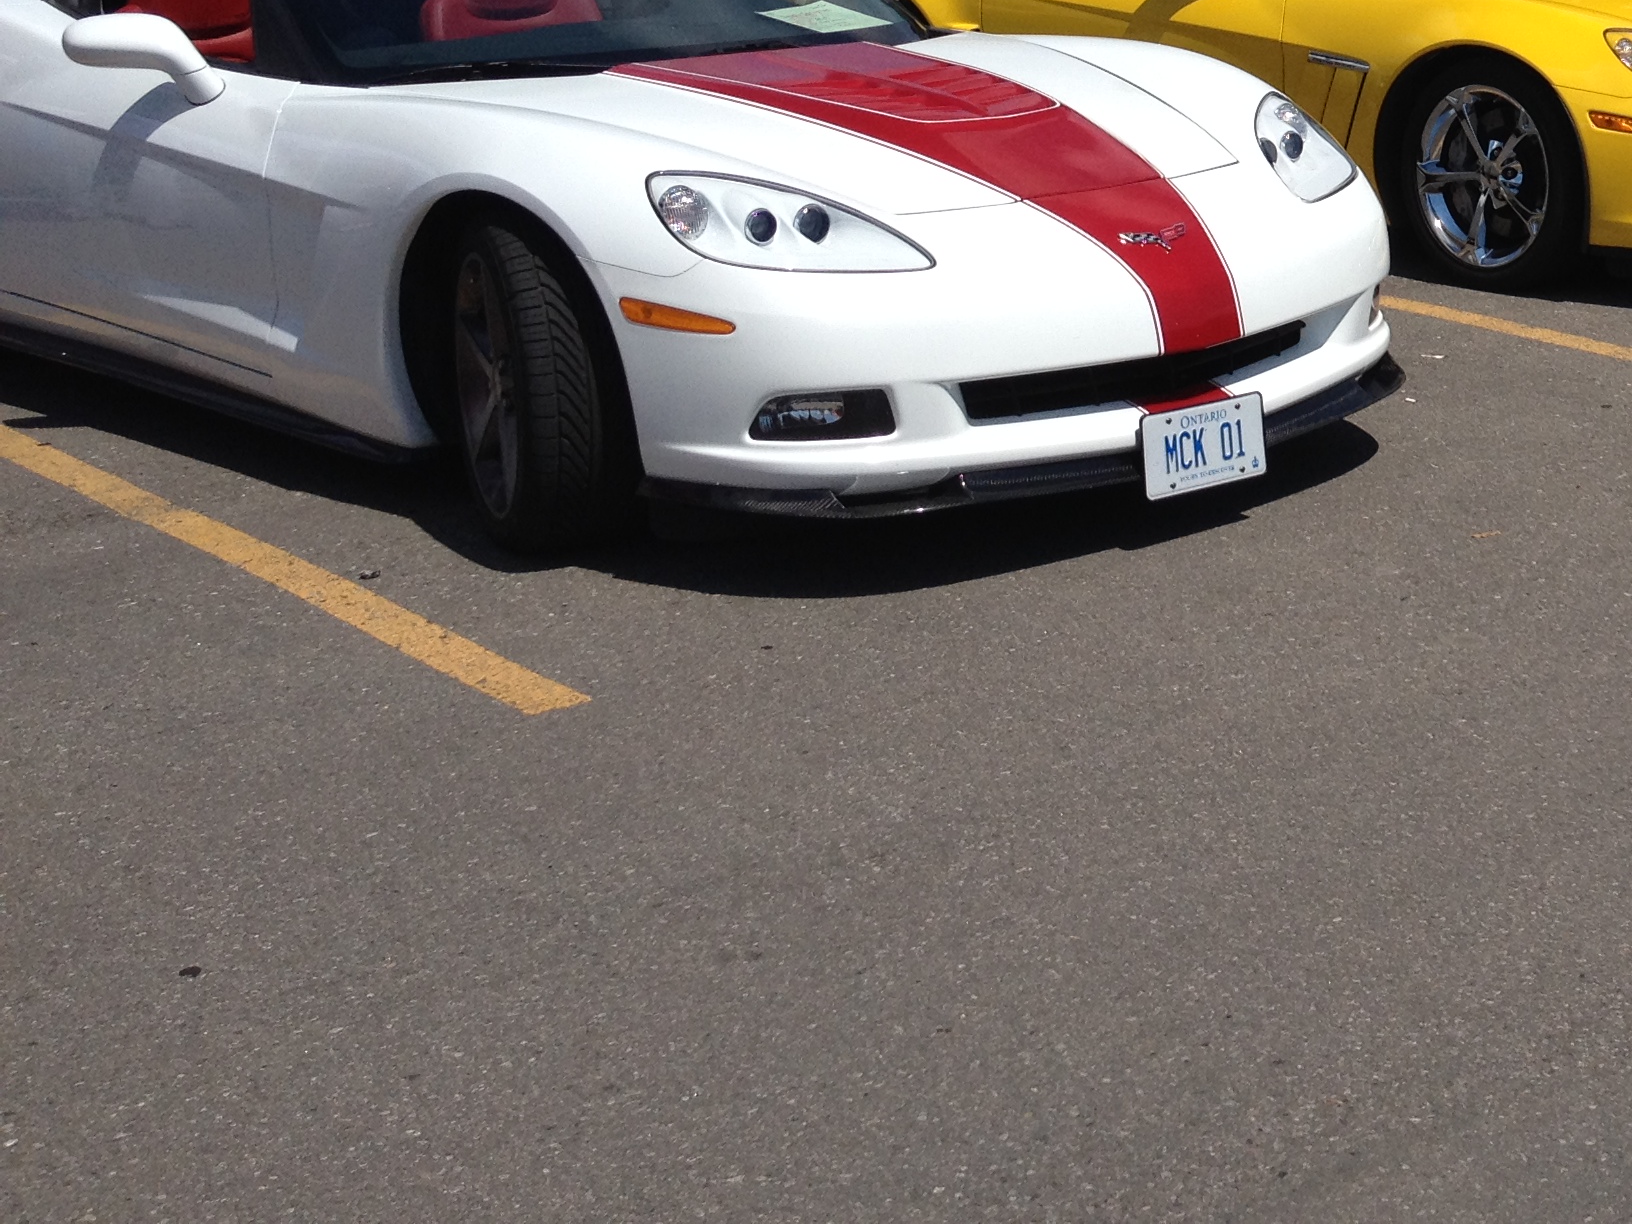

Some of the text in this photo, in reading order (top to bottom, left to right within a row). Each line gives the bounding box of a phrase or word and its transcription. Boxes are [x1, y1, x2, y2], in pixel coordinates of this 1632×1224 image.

[1180, 409, 1227, 428] ONTARIO
[1164, 419, 1246, 474] MCK 01
